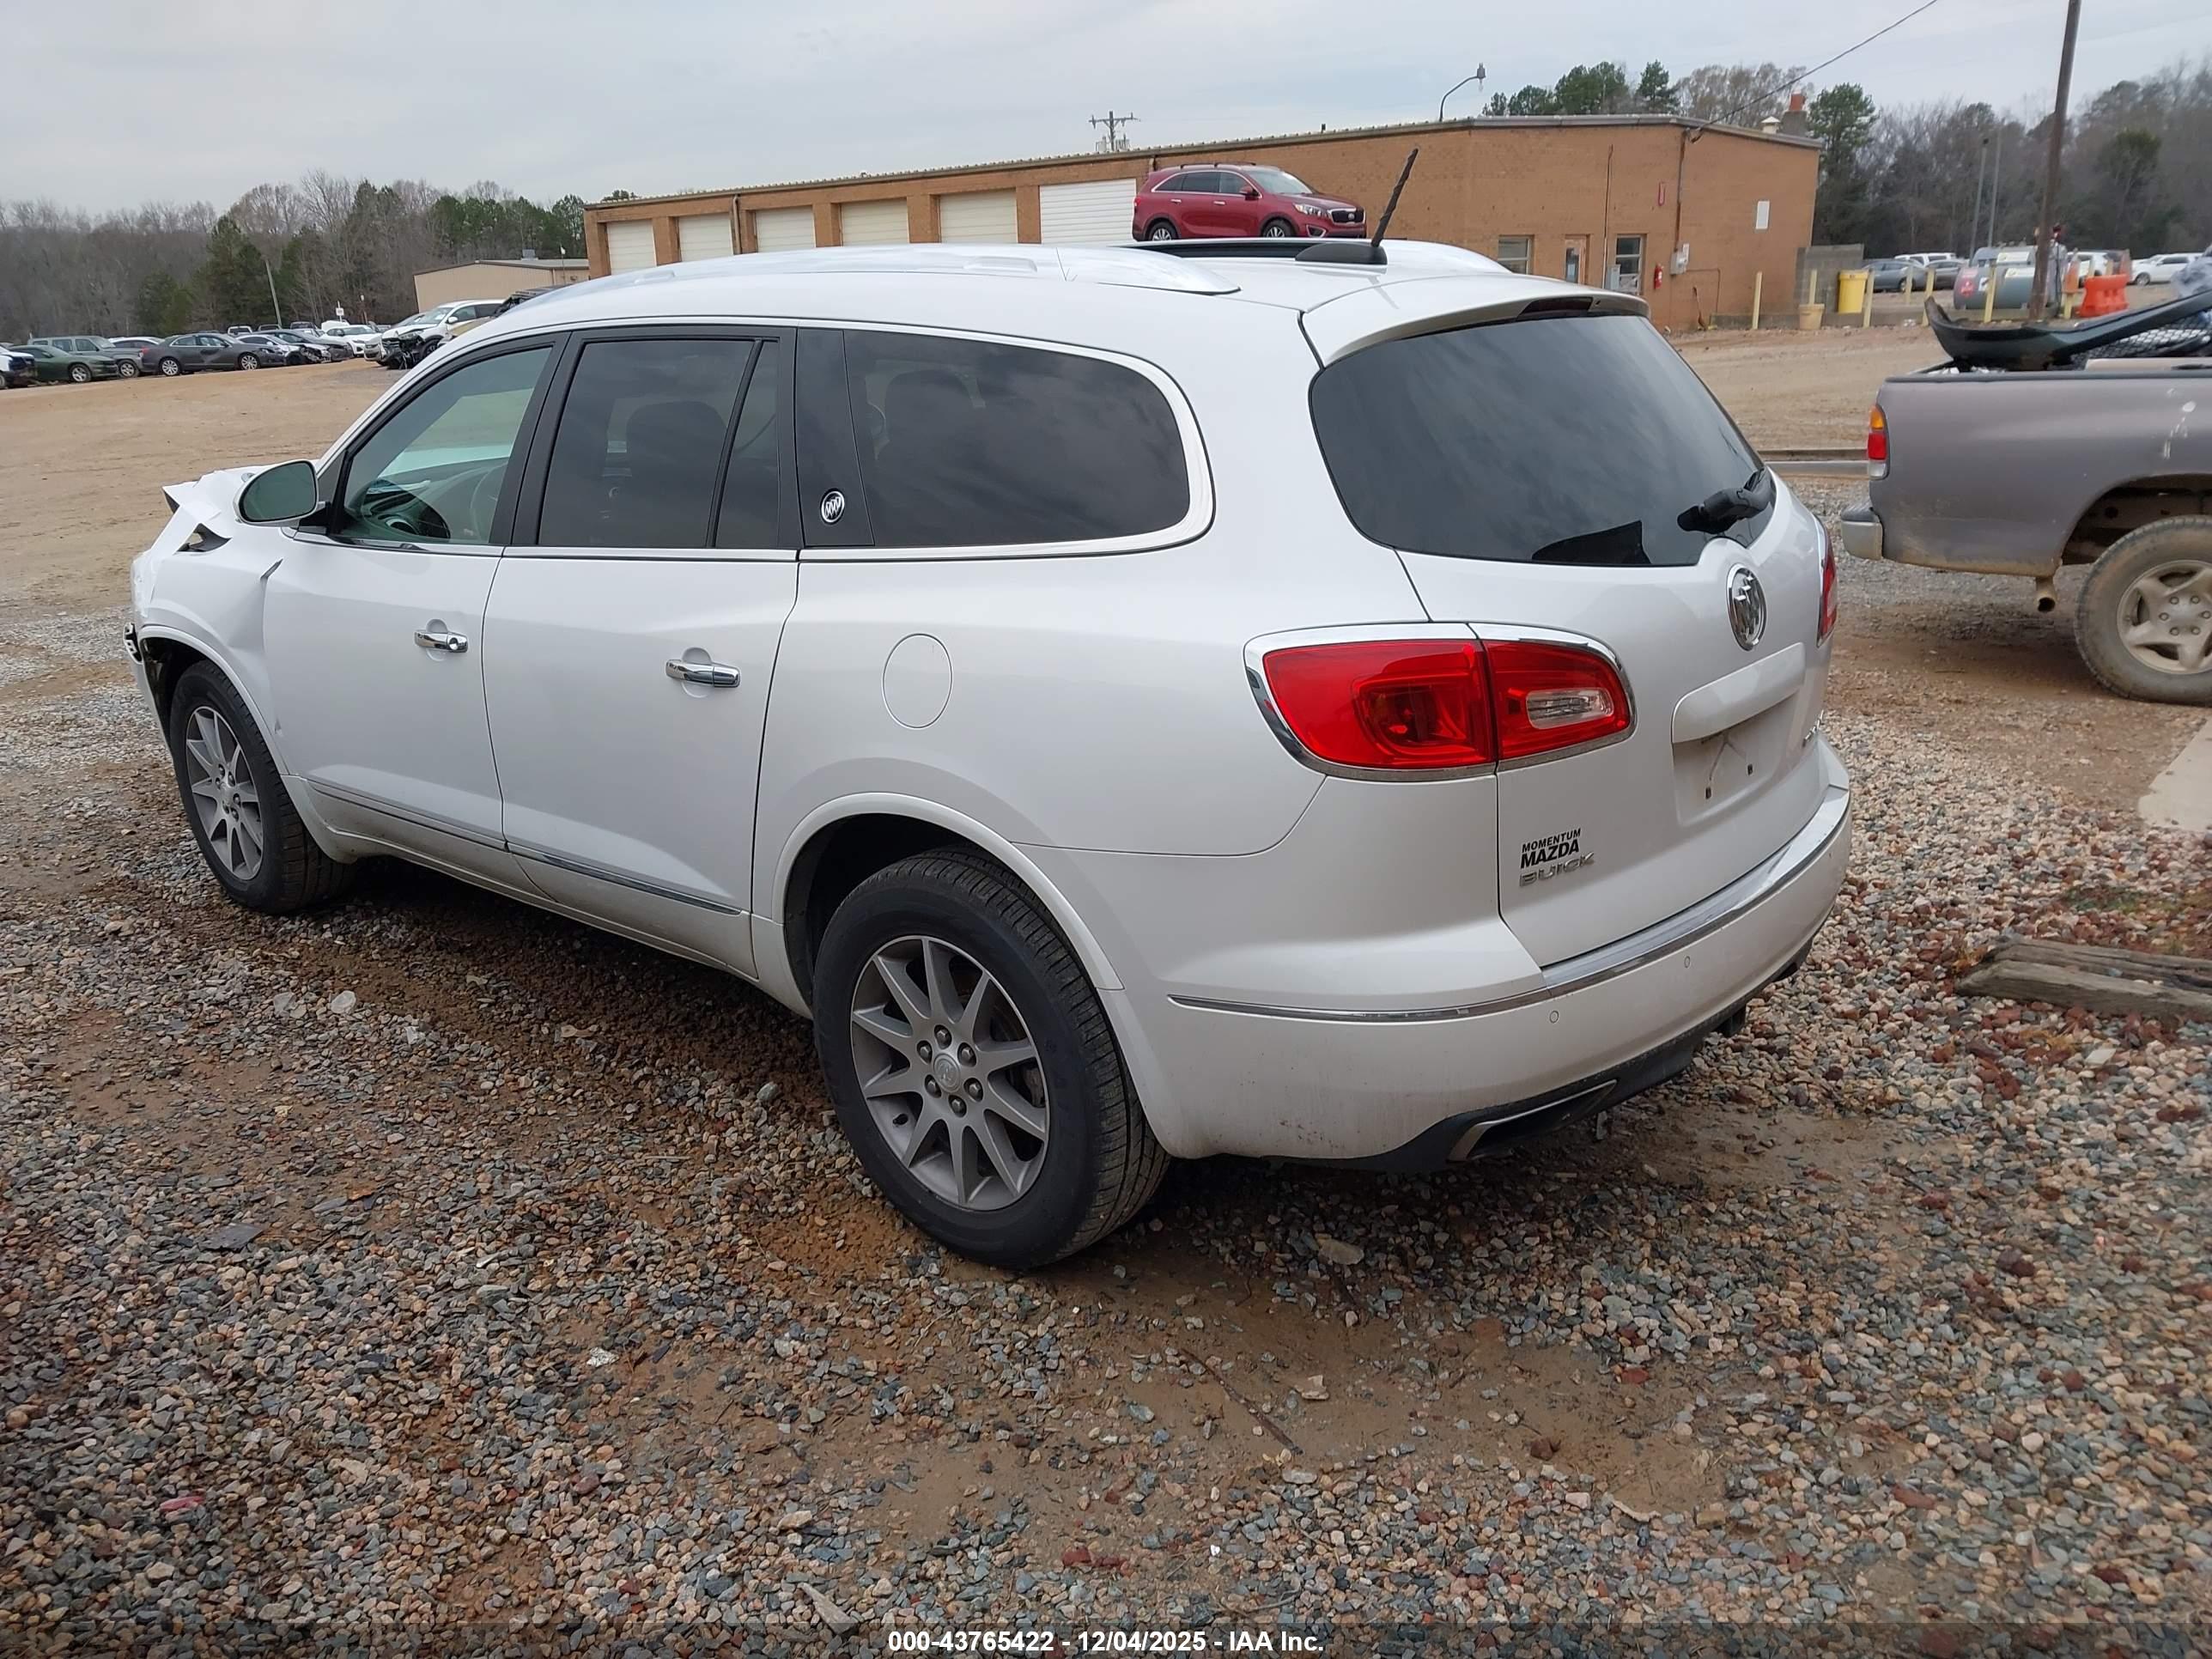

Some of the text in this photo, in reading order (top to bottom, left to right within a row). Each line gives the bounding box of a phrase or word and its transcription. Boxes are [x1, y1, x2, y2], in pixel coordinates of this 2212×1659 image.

[1520, 839, 1580, 869] MAZDA
[1522, 828, 1581, 854] MOMENTUM
[1519, 852, 1595, 887] BUICK
